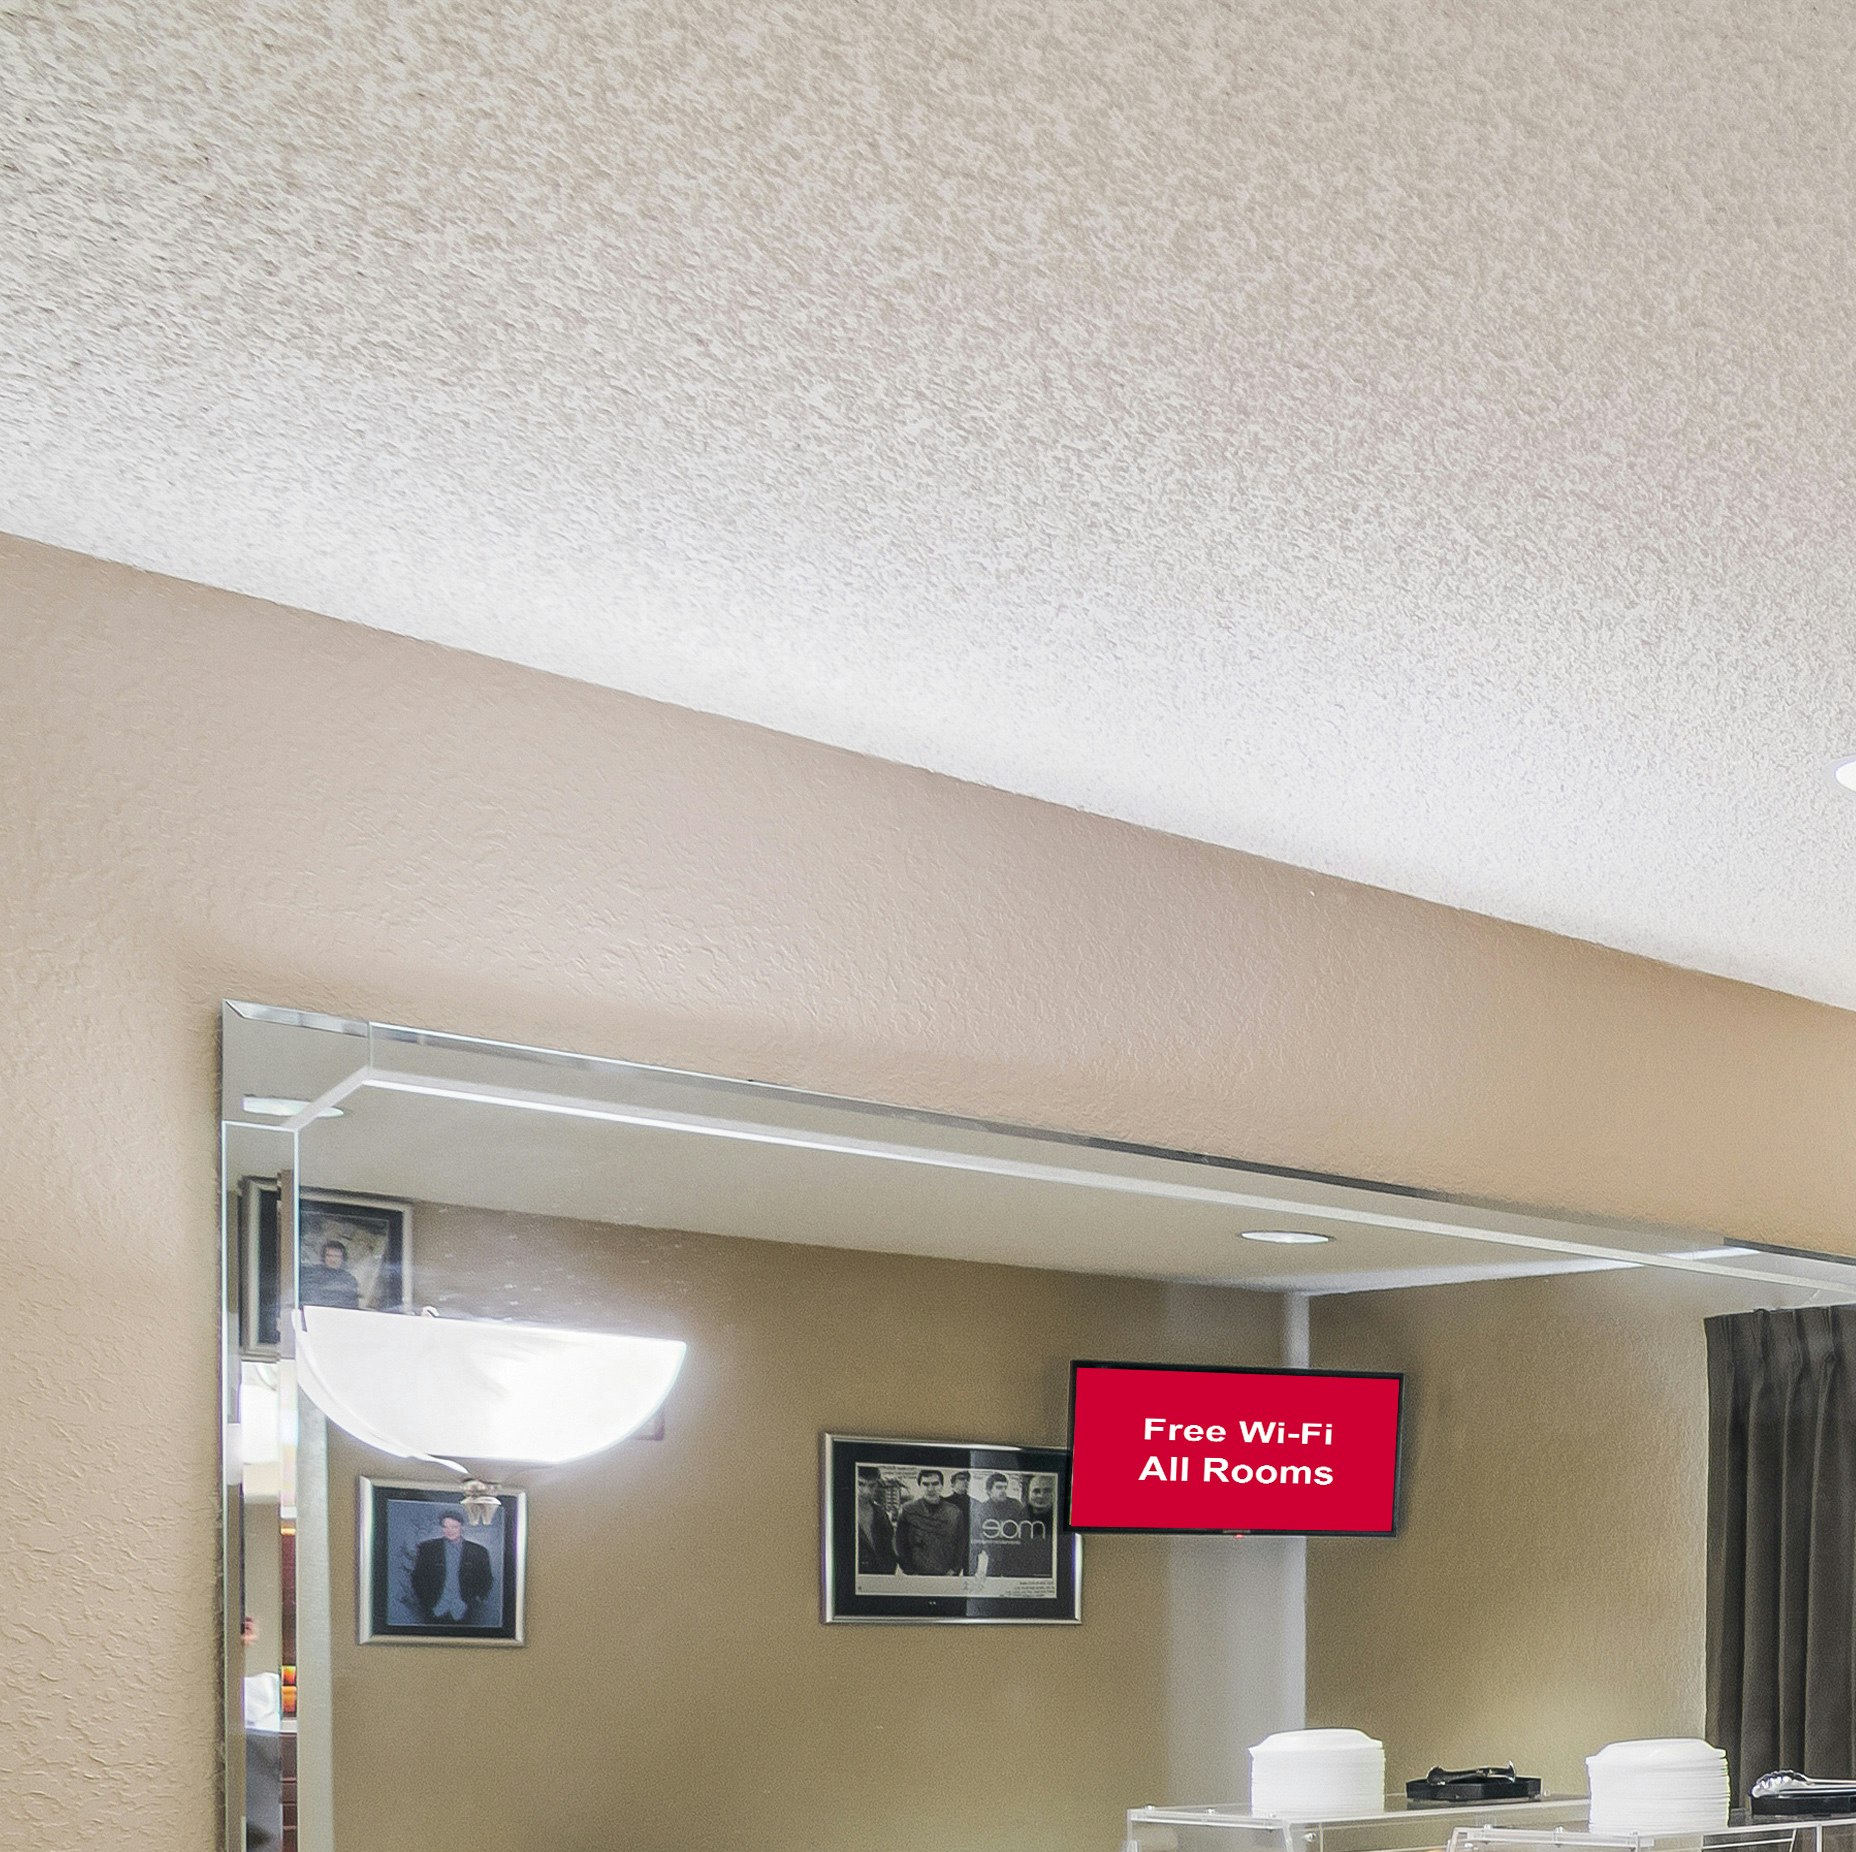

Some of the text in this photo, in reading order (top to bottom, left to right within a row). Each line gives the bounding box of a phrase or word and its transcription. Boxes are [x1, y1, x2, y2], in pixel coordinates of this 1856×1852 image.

[1145, 1418, 1333, 1445] Free Wi-Fi
[1138, 1456, 1333, 1485] All Rooms
